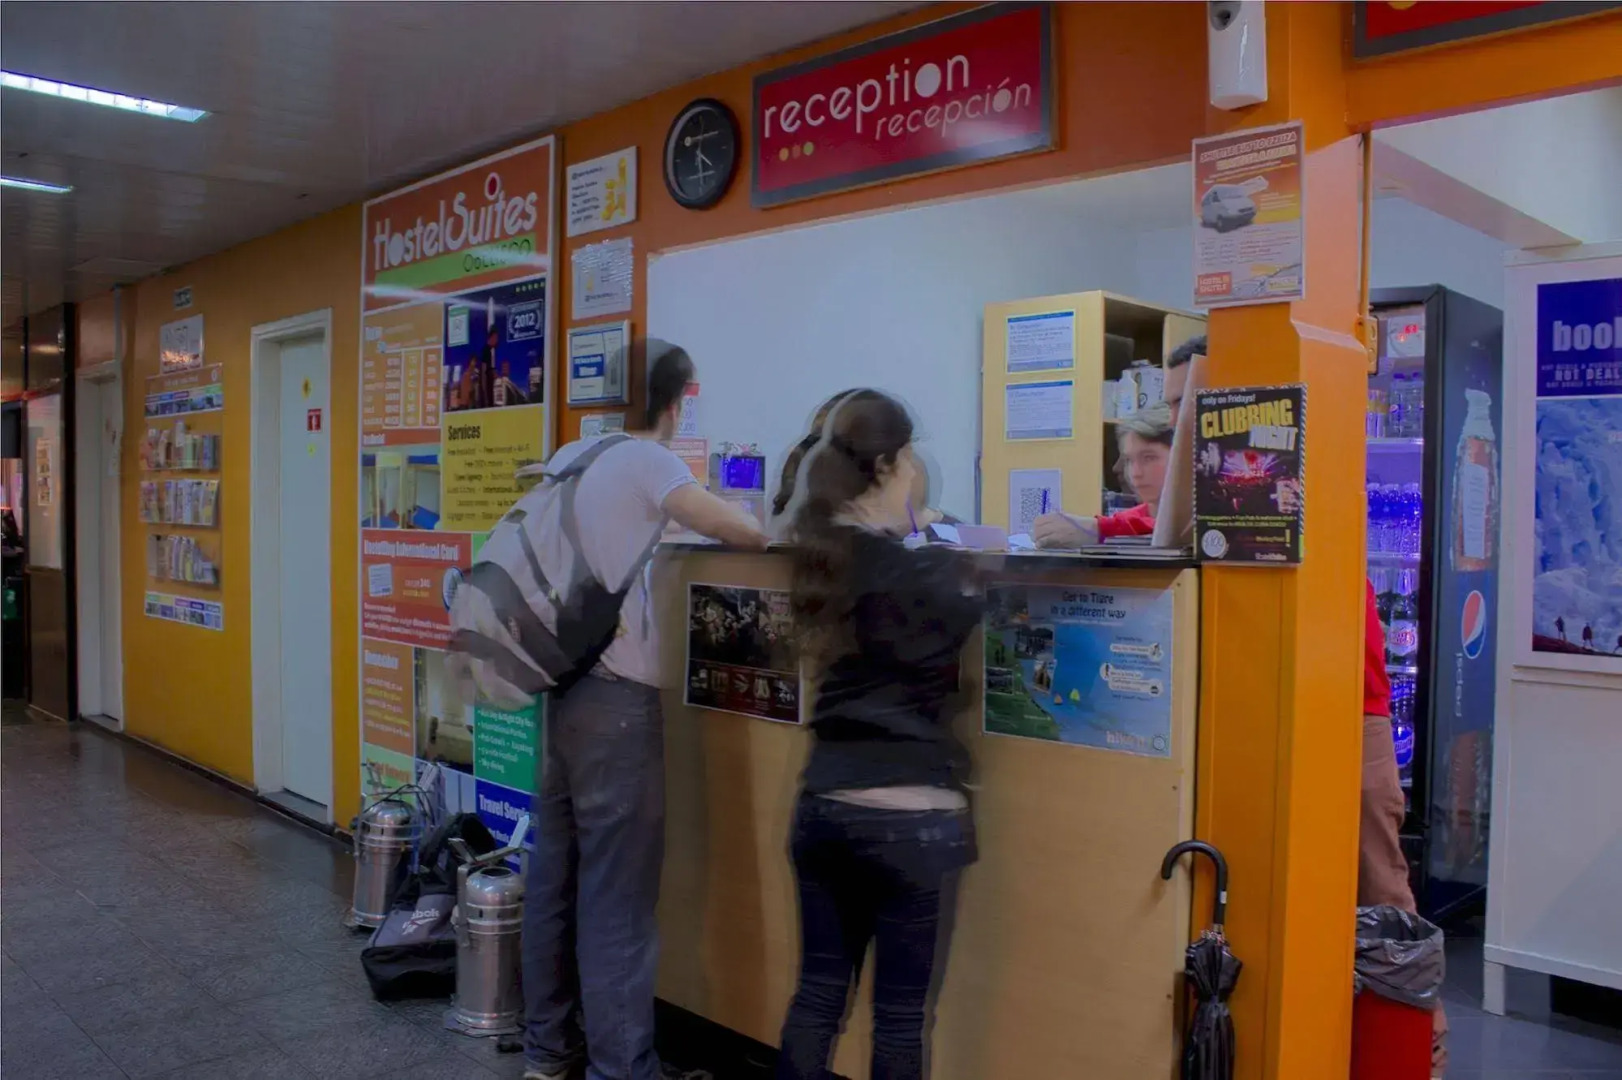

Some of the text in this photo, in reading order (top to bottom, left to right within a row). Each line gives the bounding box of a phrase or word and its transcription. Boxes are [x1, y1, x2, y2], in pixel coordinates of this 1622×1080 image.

[764, 54, 969, 138] reception
[875, 77, 1031, 140] recepción
[374, 172, 538, 271] HostelSuites
[514, 312, 535, 329] 2012
[1202, 395, 1217, 406] only
[1228, 393, 1256, 405] Fridays!
[1201, 398, 1293, 439] CLUBBING
[447, 424, 481, 441] Services
[1248, 425, 1299, 451] NIGHT
[396, 541, 440, 560] International
[441, 543, 459, 561] Card
[1080, 592, 1088, 602] to
[1090, 592, 1114, 605] Tigre
[1060, 607, 1066, 616] a
[1068, 606, 1106, 618] different
[1108, 609, 1126, 620] way
[478, 793, 503, 817] Travel
